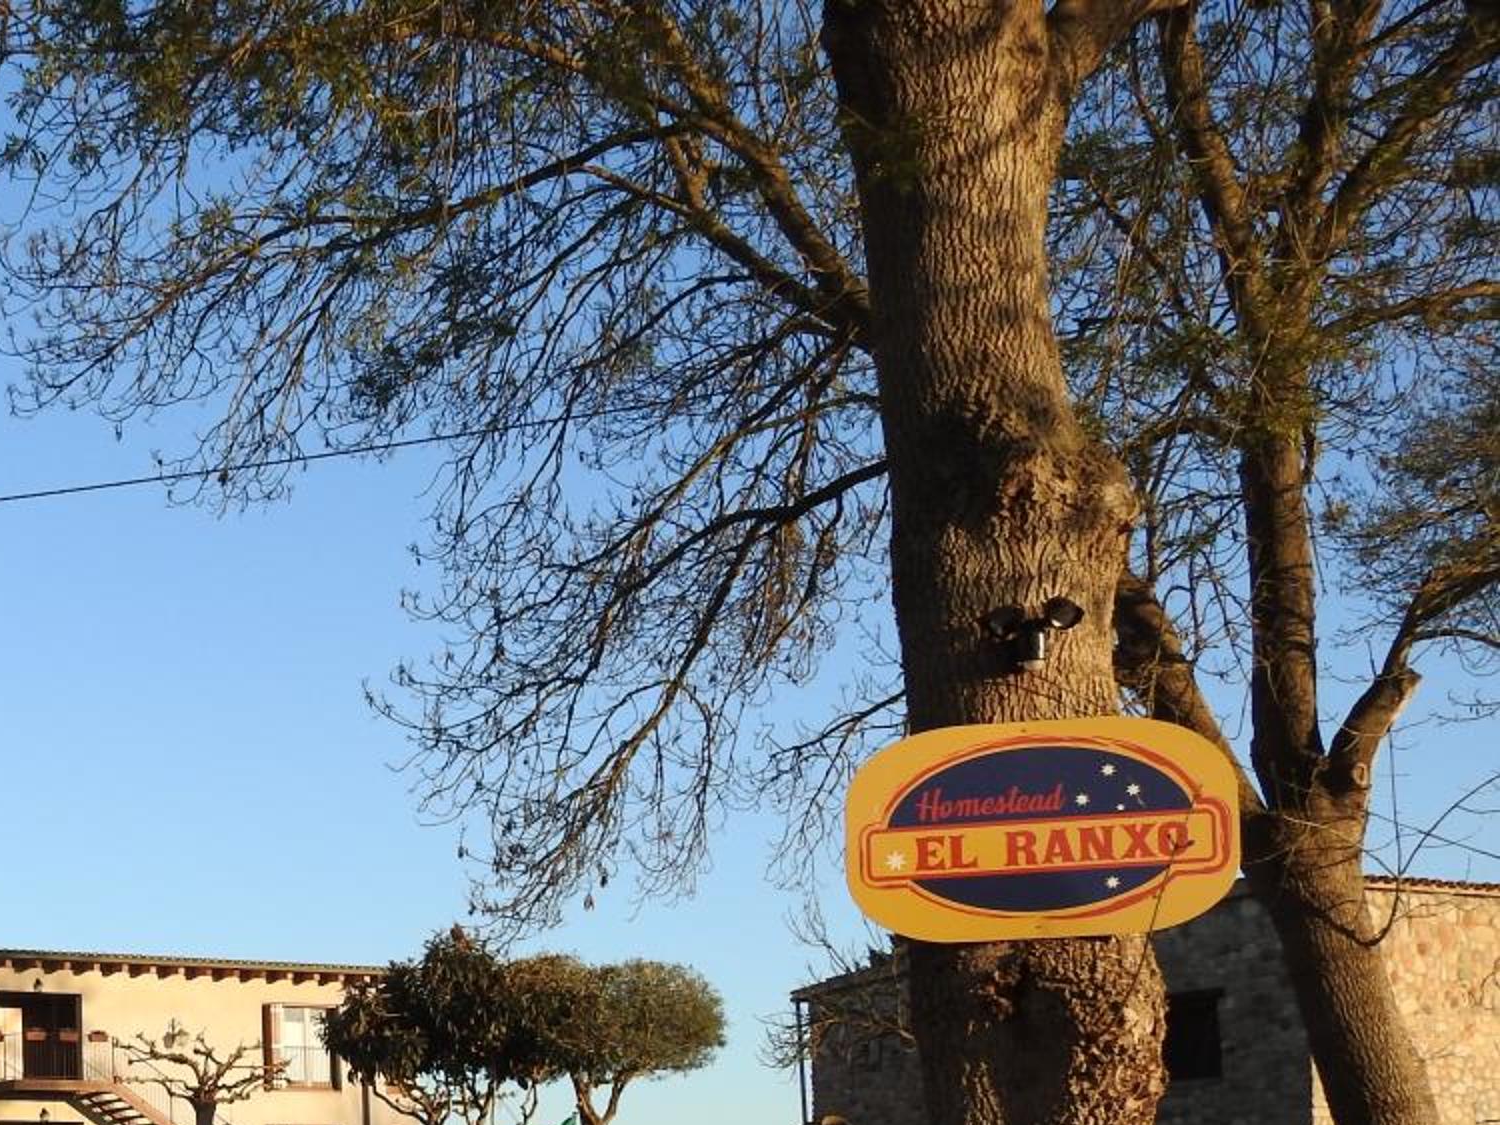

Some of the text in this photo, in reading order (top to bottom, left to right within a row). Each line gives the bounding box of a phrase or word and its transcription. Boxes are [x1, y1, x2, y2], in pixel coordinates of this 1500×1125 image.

[916, 783, 1066, 823] Homestead
[915, 821, 1190, 871] EL RANXO
